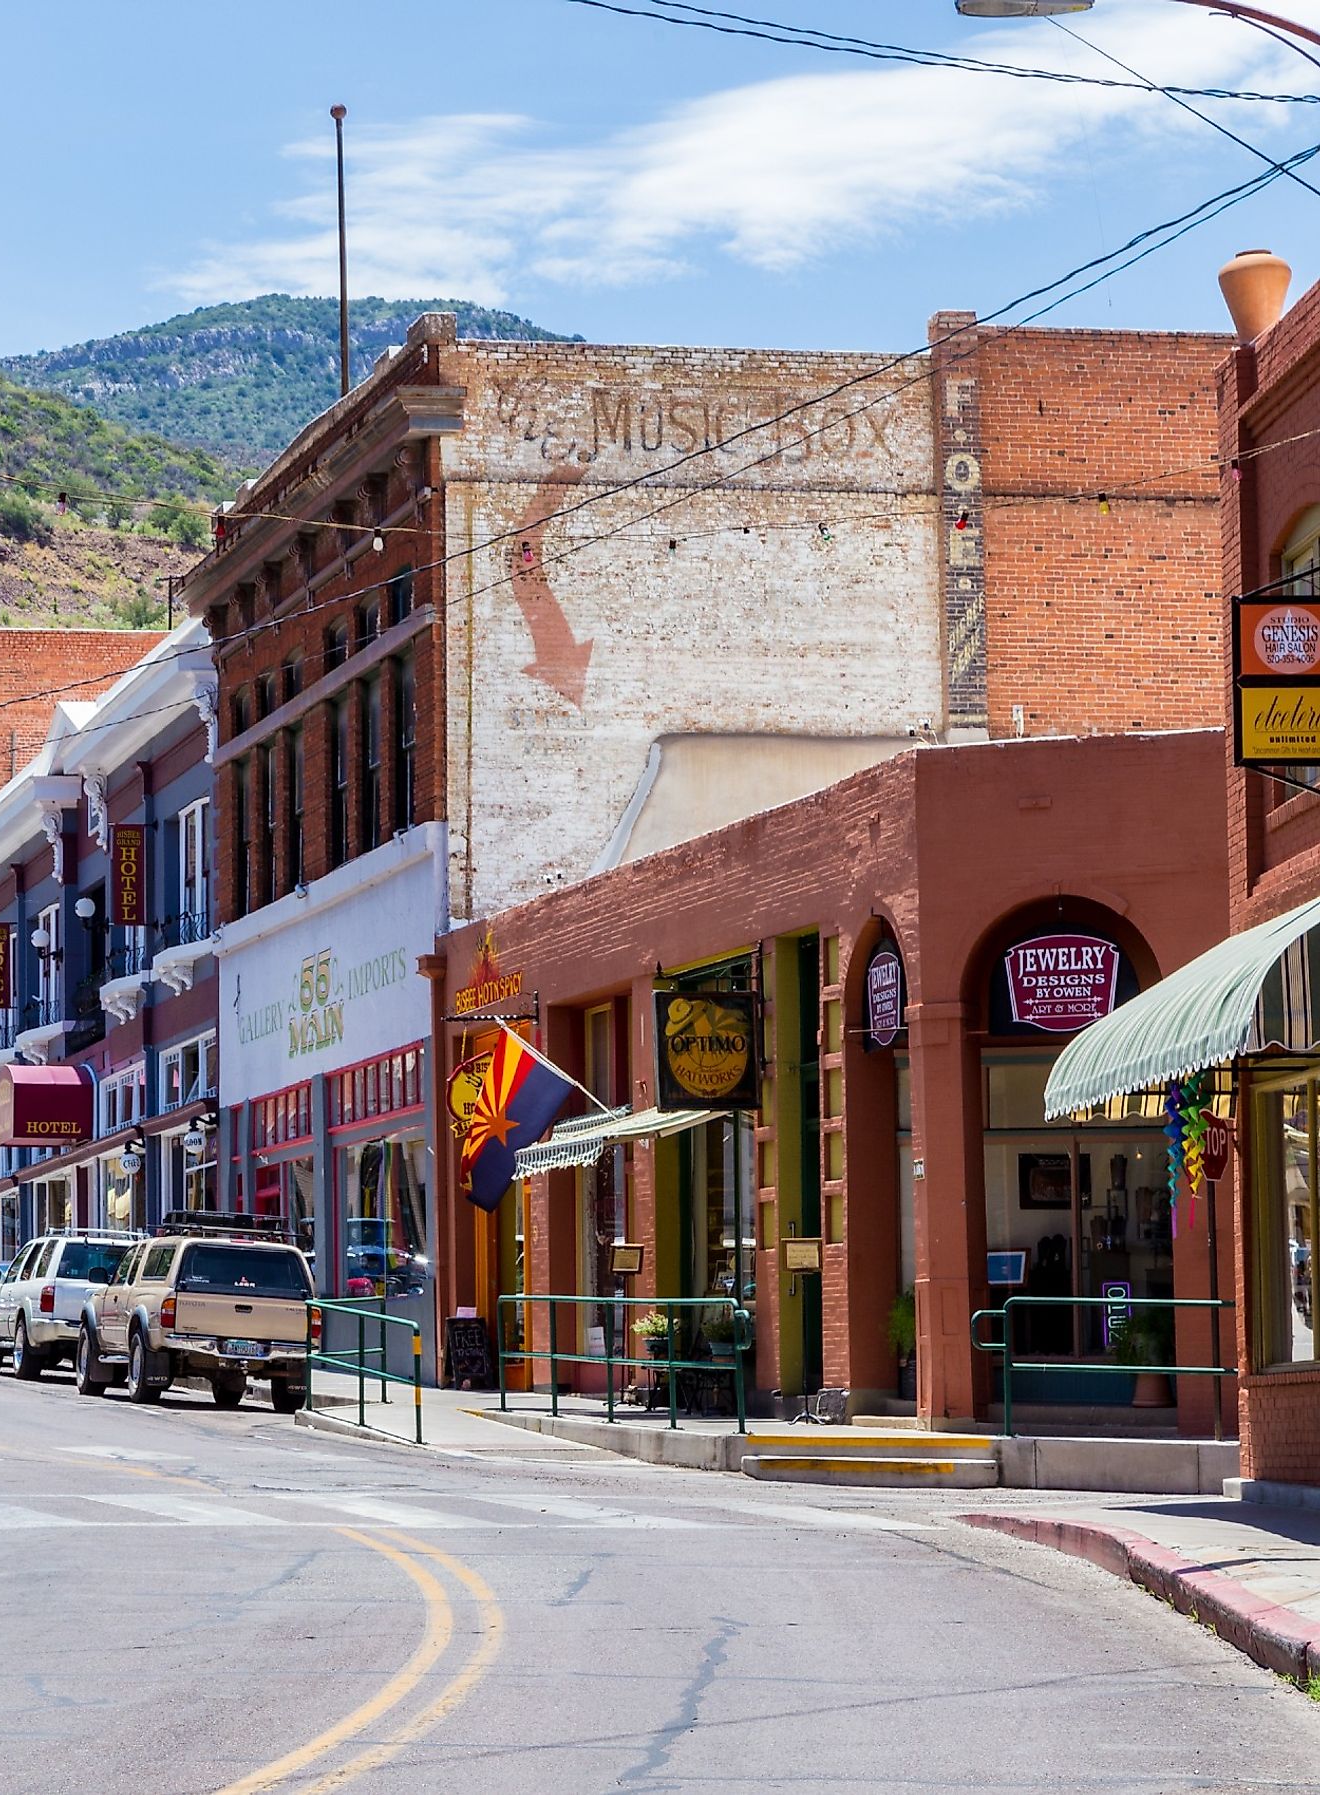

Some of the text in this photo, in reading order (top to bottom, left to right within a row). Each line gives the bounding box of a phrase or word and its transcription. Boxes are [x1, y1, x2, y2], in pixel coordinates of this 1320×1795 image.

[580, 388, 740, 463] MUSIC
[1270, 615, 1310, 624] STUDIO
[1261, 624, 1319, 642] GENESIS
[1265, 642, 1316, 653] HAIR SALON
[1269, 735, 1316, 744] unlimited
[120, 847, 137, 920] HOTEL
[1018, 946, 1107, 979] JEWELRY
[300, 947, 332, 1012] 55
[872, 961, 897, 992] JEWELRY
[1022, 973, 1106, 988] DESIGNS
[239, 947, 406, 1045] GALLERY IMPORTS
[456, 988, 476, 1015] BISBEE
[500, 971, 522, 1003] SPICY
[873, 987, 897, 1004] DESIGNS
[1036, 986, 1092, 998] BY OWEN
[1031, 1002, 1098, 1014] ART & MORE
[288, 999, 345, 1059] MAIN
[671, 1034, 746, 1054] OPTIMO
[26, 1121, 82, 1134] HOTEL
[1201, 1126, 1226, 1156] TOP
[179, 1300, 206, 1308] TOYOTA
[455, 1328, 483, 1348] FREE
